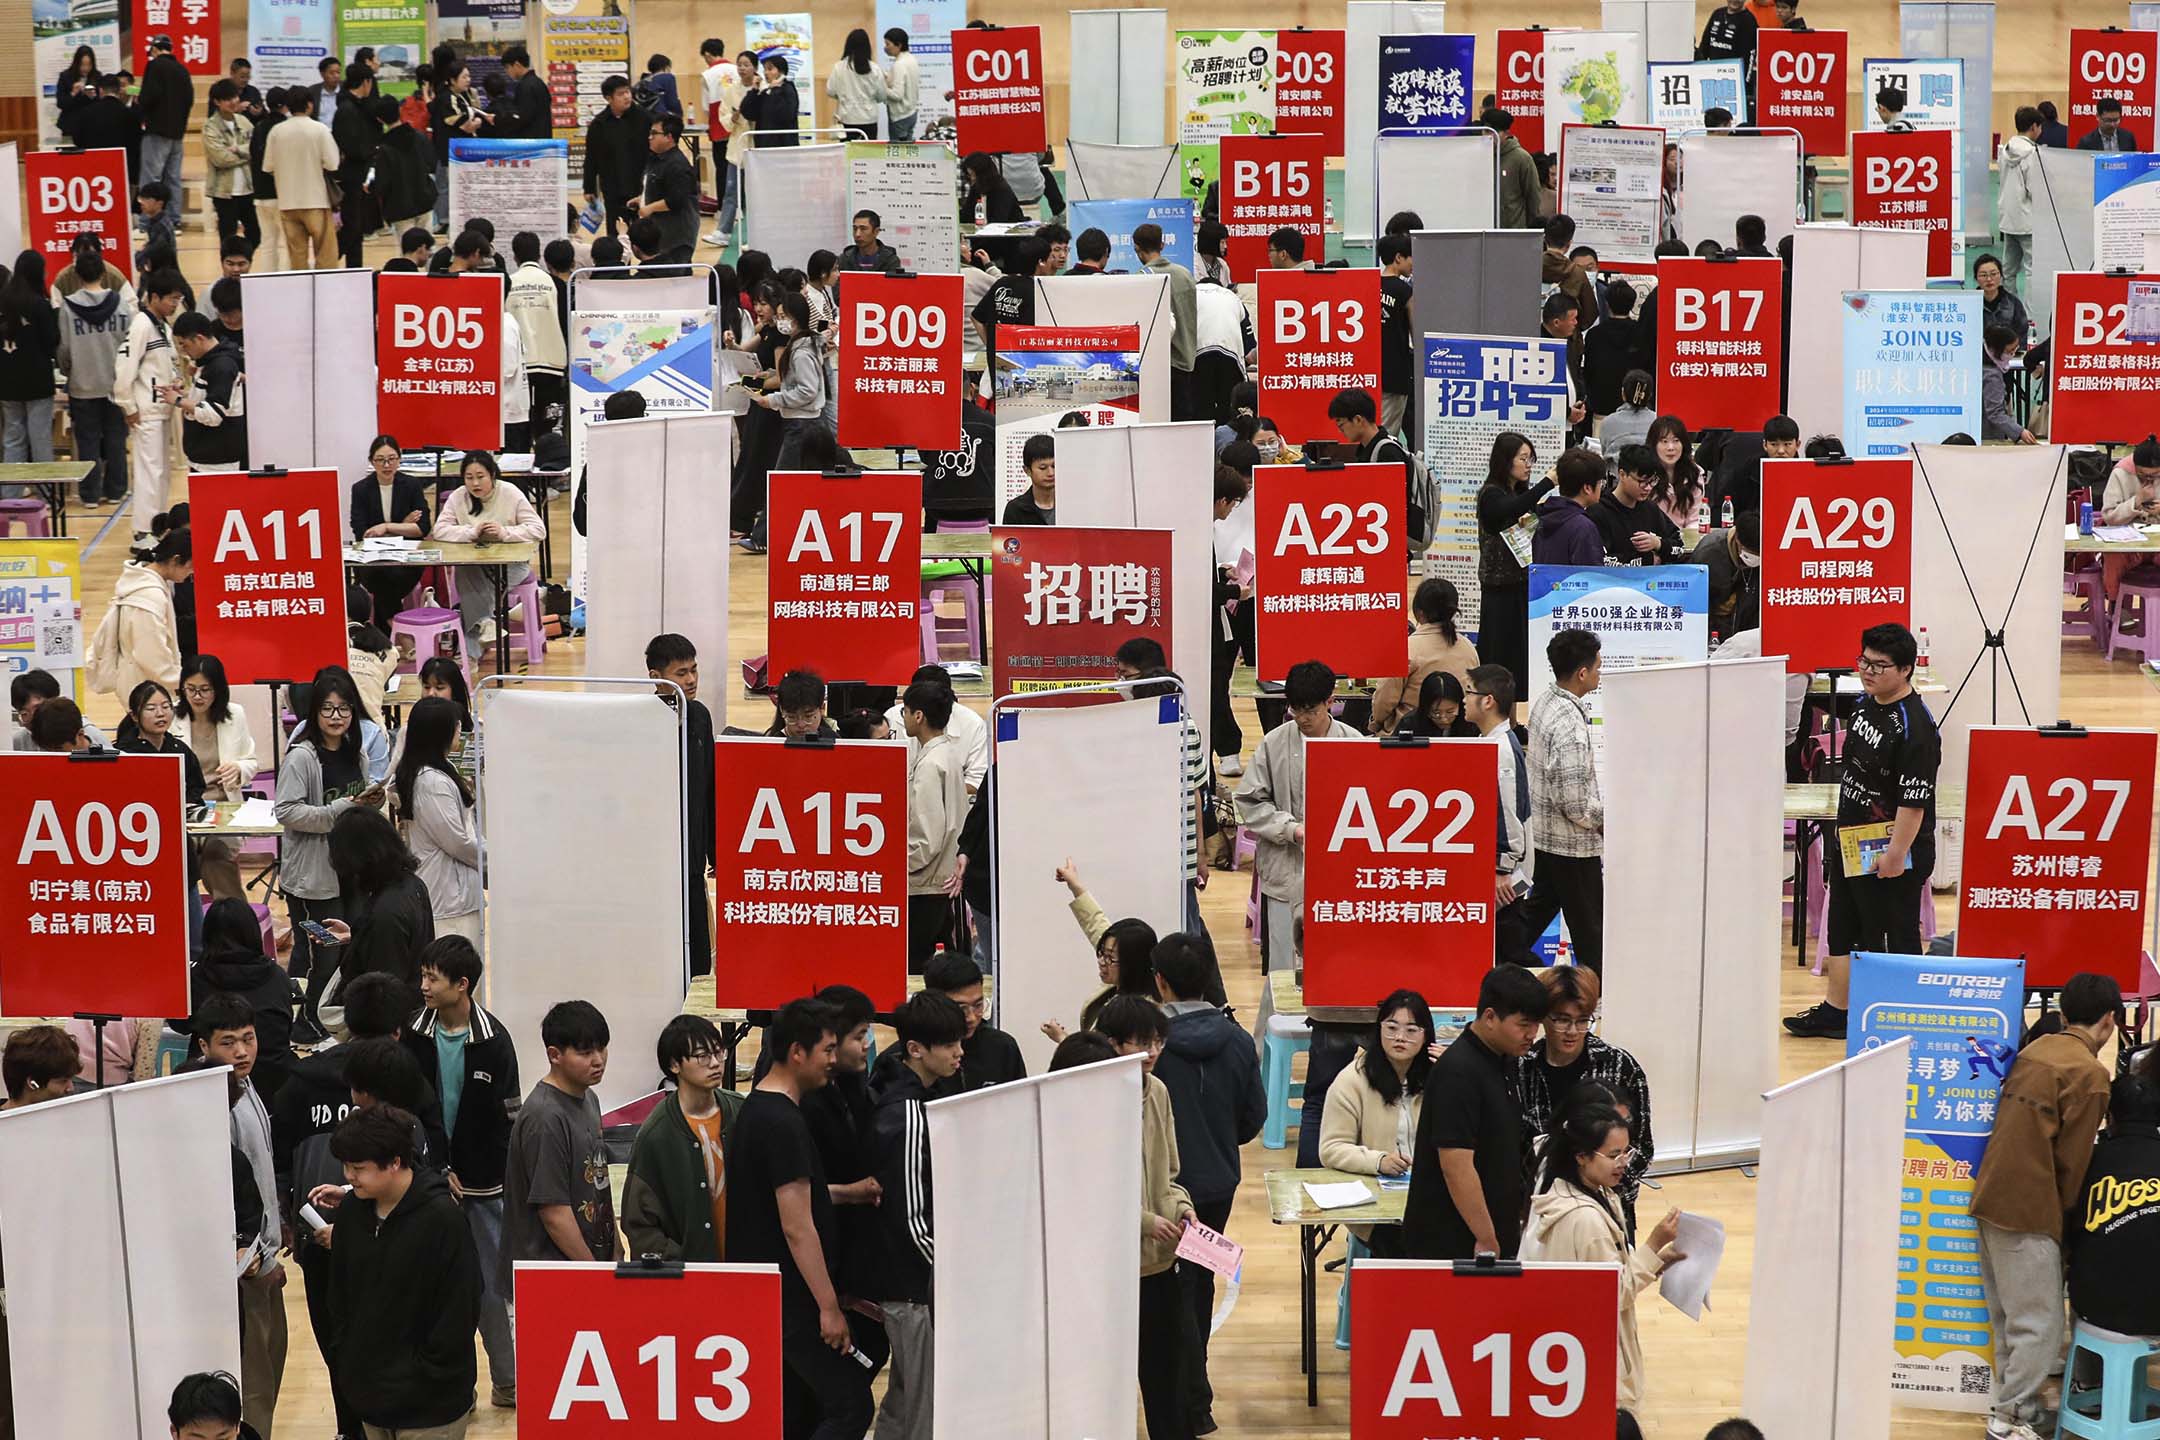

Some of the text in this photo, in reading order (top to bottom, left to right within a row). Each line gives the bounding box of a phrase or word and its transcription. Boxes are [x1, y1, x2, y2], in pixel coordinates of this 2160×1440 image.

[966, 49, 1029, 82] C01
[1190, 56, 1247, 74] 高薪岗位
[1769, 50, 1836, 84] C07
[2081, 50, 2146, 84] C09
[1203, 68, 1262, 88] 招聘计划
[1388, 66, 1465, 97] 招聘精英
[1780, 89, 1824, 101] 淮安品向
[959, 102, 1041, 116] 集团有限责任公司
[1276, 106, 1333, 120] 运有限公司
[1768, 105, 1835, 117] 科技有限公司
[1234, 159, 1310, 198] B15
[1866, 156, 1945, 194] B23
[39, 176, 114, 214] B03
[1233, 204, 1313, 219] 淮安市奥森满电
[1675, 288, 1765, 332] B17
[1889, 302, 1959, 313] 得科智能科技
[394, 304, 485, 350] B05
[855, 302, 947, 349] B09
[1275, 299, 1365, 344] B13
[2073, 302, 2156, 346] B2
[1019, 337, 1119, 347] 江苏洁丽莱科技有限公司
[1676, 340, 1762, 356] 得科智能科技
[1880, 330, 1965, 347] JOIN US
[404, 358, 475, 373] 金丰(江苏)
[864, 356, 939, 373] 江苏洁丽莱
[1284, 352, 1354, 368] 艾博纳科技
[1875, 348, 1954, 363] 欢迎加入我们
[1262, 374, 1377, 390] (江苏)有限责任公司
[1438, 341, 1568, 421] 招聘
[1669, 363, 1767, 378] (淮安)有限公司
[383, 379, 496, 396] 机械工业有限公司
[855, 378, 946, 395] 科技有限公司
[1272, 502, 1390, 557] A23
[1778, 496, 1896, 550] A29
[213, 508, 323, 563] A11
[787, 508, 904, 563] A17
[223, 571, 316, 591] 南京虹启旭
[1299, 565, 1366, 586] 康辉南通
[1800, 559, 1874, 579] 同程网络
[799, 573, 890, 592] 南通销三郎
[1022, 561, 1150, 627] 招聘
[215, 597, 325, 619] 食品有限公司
[1263, 592, 1402, 614] 新材料科技有限公司
[1766, 586, 1906, 607] 科技股份有限公司
[773, 601, 915, 620] 网络科技有限公司
[1551, 605, 1684, 620] 世界500强企业招募
[1551, 620, 1683, 632] 康辉南通新材料科技有限公司
[1852, 714, 1883, 749] BOOM
[1326, 785, 1475, 855] A22
[1984, 774, 2132, 843] A27
[16, 799, 161, 867] A09
[738, 787, 886, 858] A15
[2011, 854, 2103, 878] 苏州博睿
[29, 879, 153, 902] 归宁集(南京)
[742, 868, 883, 894] 南京欣网通信
[1354, 866, 1448, 891] 江苏丰声
[1967, 886, 2140, 912] 测控设备有限公司
[27, 911, 156, 935] 食品有限公司
[723, 901, 900, 928] 科技股份有限公司
[1311, 899, 1488, 925] 信息科技有限公司
[1948, 988, 2003, 1000] 博睿测控
[1875, 1010, 1999, 1029] 苏州博睿测控设备有限公司
[1943, 1087, 1997, 1100] JOIN US
[1933, 1099, 1996, 1126] 为你来
[2084, 1176, 2160, 1233] HUGS
[548, 1329, 751, 1424] A13
[1380, 1327, 1588, 1419] A19
